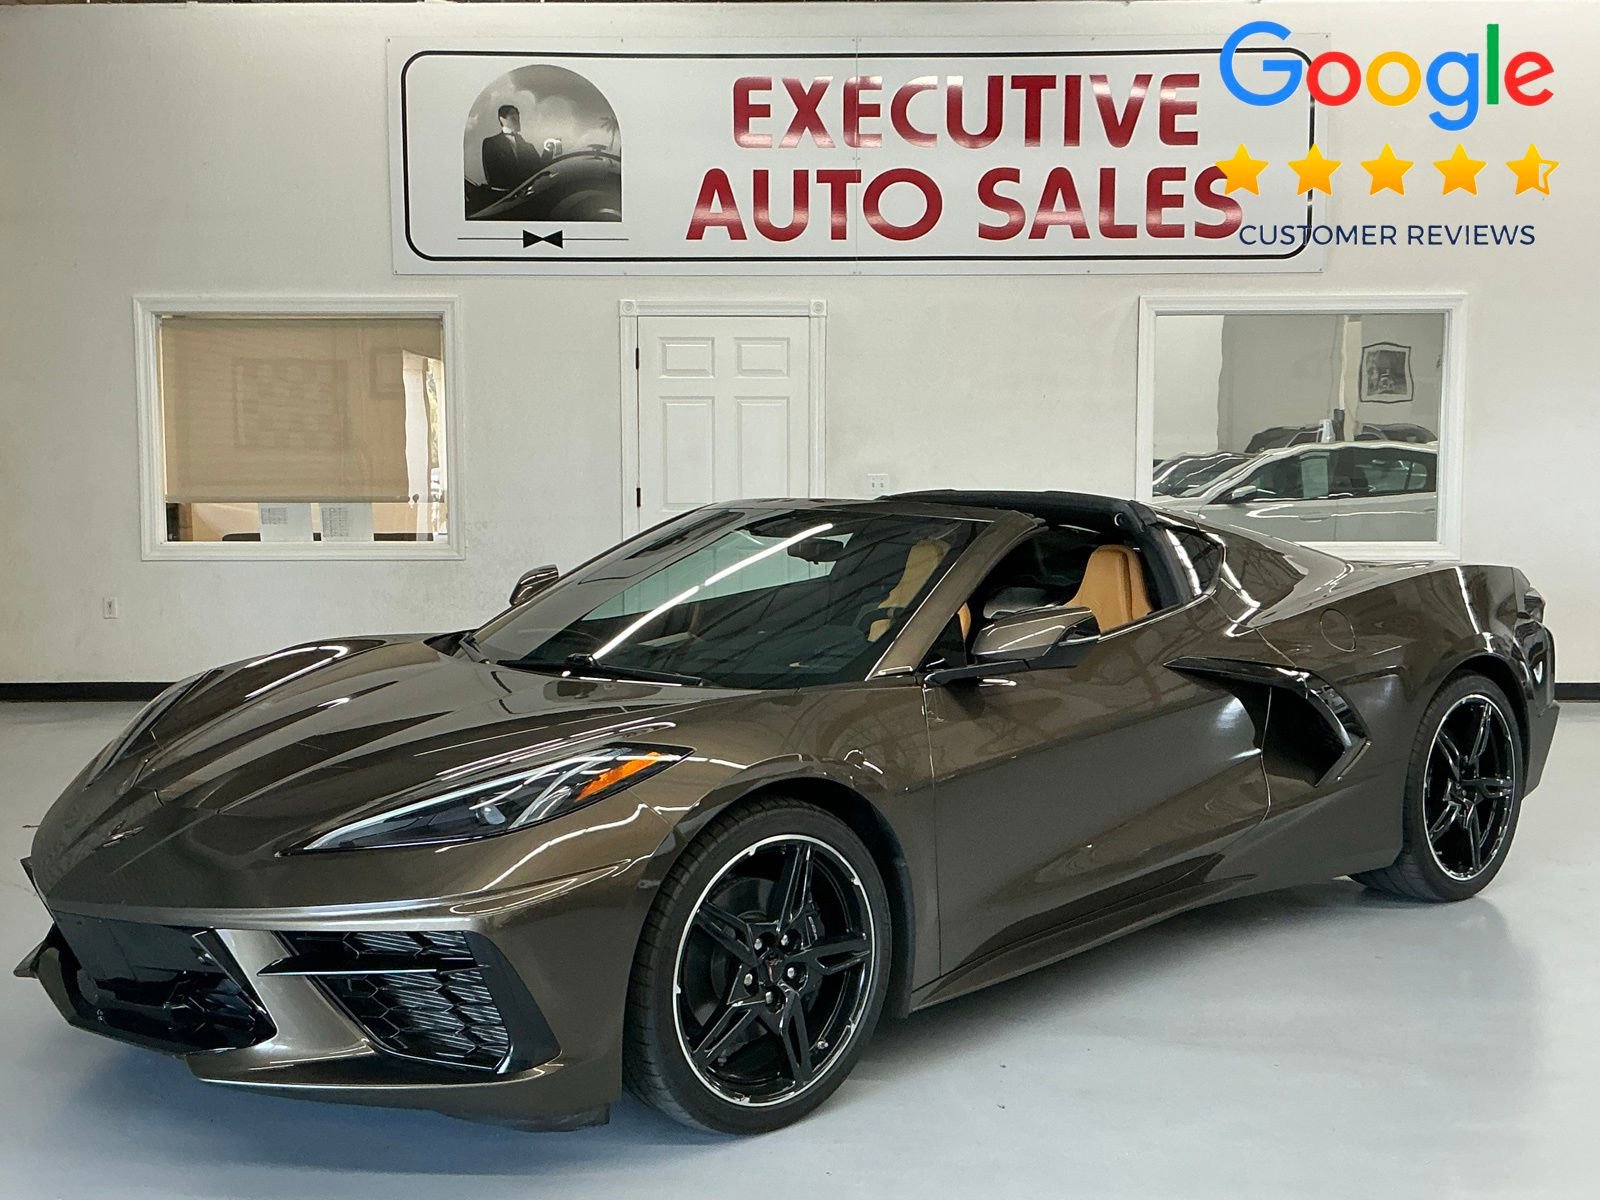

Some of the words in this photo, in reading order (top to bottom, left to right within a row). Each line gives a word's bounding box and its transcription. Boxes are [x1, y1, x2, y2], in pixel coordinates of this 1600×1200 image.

[733, 74, 1200, 148] EXECUTIVE
[686, 168, 943, 242] AUTO
[977, 166, 1243, 240] SALES
